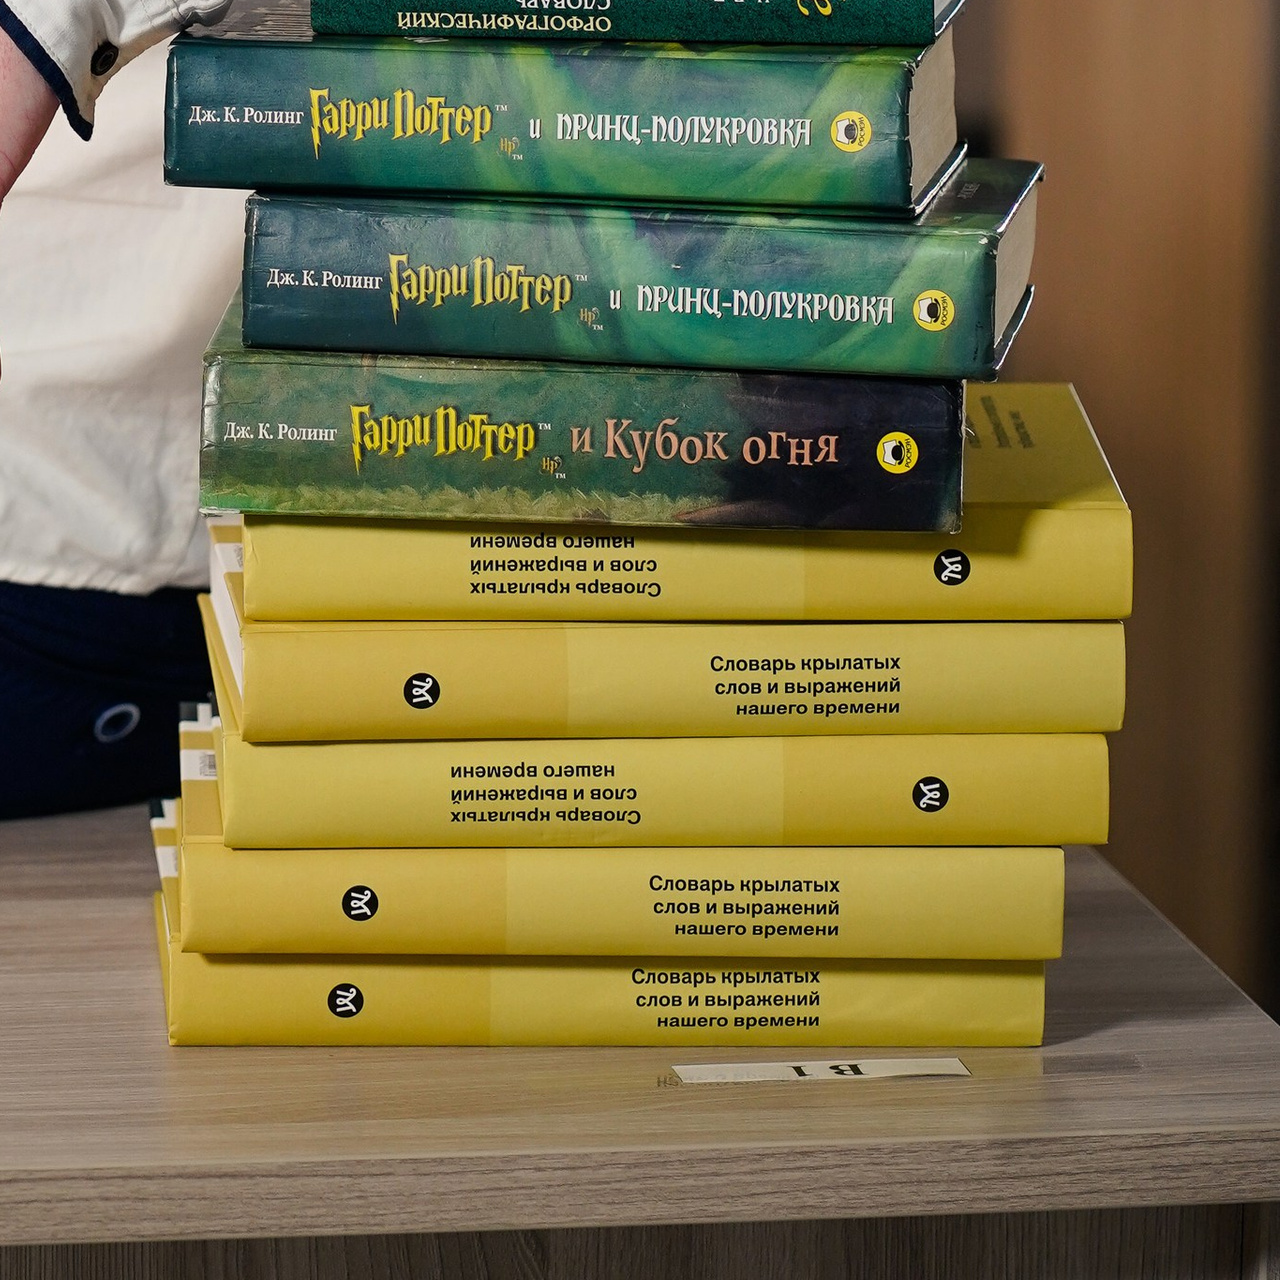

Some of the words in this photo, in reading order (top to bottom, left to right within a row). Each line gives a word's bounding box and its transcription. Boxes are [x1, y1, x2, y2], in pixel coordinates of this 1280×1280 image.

[397, 12, 612, 32] ОРФОГРАФИЧЕСКИЙ
[188, 106, 220, 125] Дж.
[223, 107, 240, 123] К.
[243, 107, 304, 125] Ролинг
[309, 87, 390, 160] Гарри
[529, 117, 542, 139] и
[556, 112, 813, 148] ПРИНЦ-ПОЛУКРОВКА
[266, 268, 299, 288] Дж.
[302, 270, 319, 287] К.
[322, 272, 383, 290] Ролинг
[388, 253, 469, 325] Гарри
[609, 290, 621, 310] и
[637, 285, 895, 326] ПРИНЦ-ПОЛУКРОВКА
[224, 422, 254, 441] Дж.
[258, 423, 274, 440] К.
[277, 423, 338, 442] Ролинг
[350, 404, 433, 475] Гарри
[570, 427, 593, 454] и
[604, 417, 729, 473] Кубок
[742, 431, 839, 467] огня
[470, 532, 557, 549] времени
[563, 536, 635, 549] нашего
[470, 555, 587, 575] выражений
[593, 559, 605, 572] и
[610, 559, 657, 572] слов
[470, 578, 570, 594] крылатых
[575, 578, 662, 598] Словарь
[710, 655, 796, 675] Словарь
[801, 657, 901, 675] крылатых
[715, 682, 762, 695] слов
[767, 682, 779, 694] и
[784, 677, 901, 698] выражений
[736, 703, 808, 716] нашего
[813, 702, 900, 718] времени
[451, 761, 538, 778] времени
[543, 764, 615, 778] нашего
[451, 784, 568, 805] выражений
[573, 788, 584, 800] и
[590, 788, 637, 801] слов
[450, 807, 550, 822] крылатых
[555, 806, 641, 825] Словарь
[649, 874, 735, 896] Словарь
[740, 879, 840, 896] крылатых
[653, 902, 701, 914] слов
[706, 902, 717, 914] и
[723, 900, 840, 919] выражений
[675, 924, 747, 936] нашего
[752, 924, 839, 939] времени
[631, 967, 717, 988] Словарь
[721, 970, 820, 988] крылатых
[636, 995, 682, 1007] слов
[688, 995, 699, 1007] и
[705, 991, 820, 1011] выражений
[657, 1016, 729, 1028] нашего
[733, 1016, 820, 1030] времени
